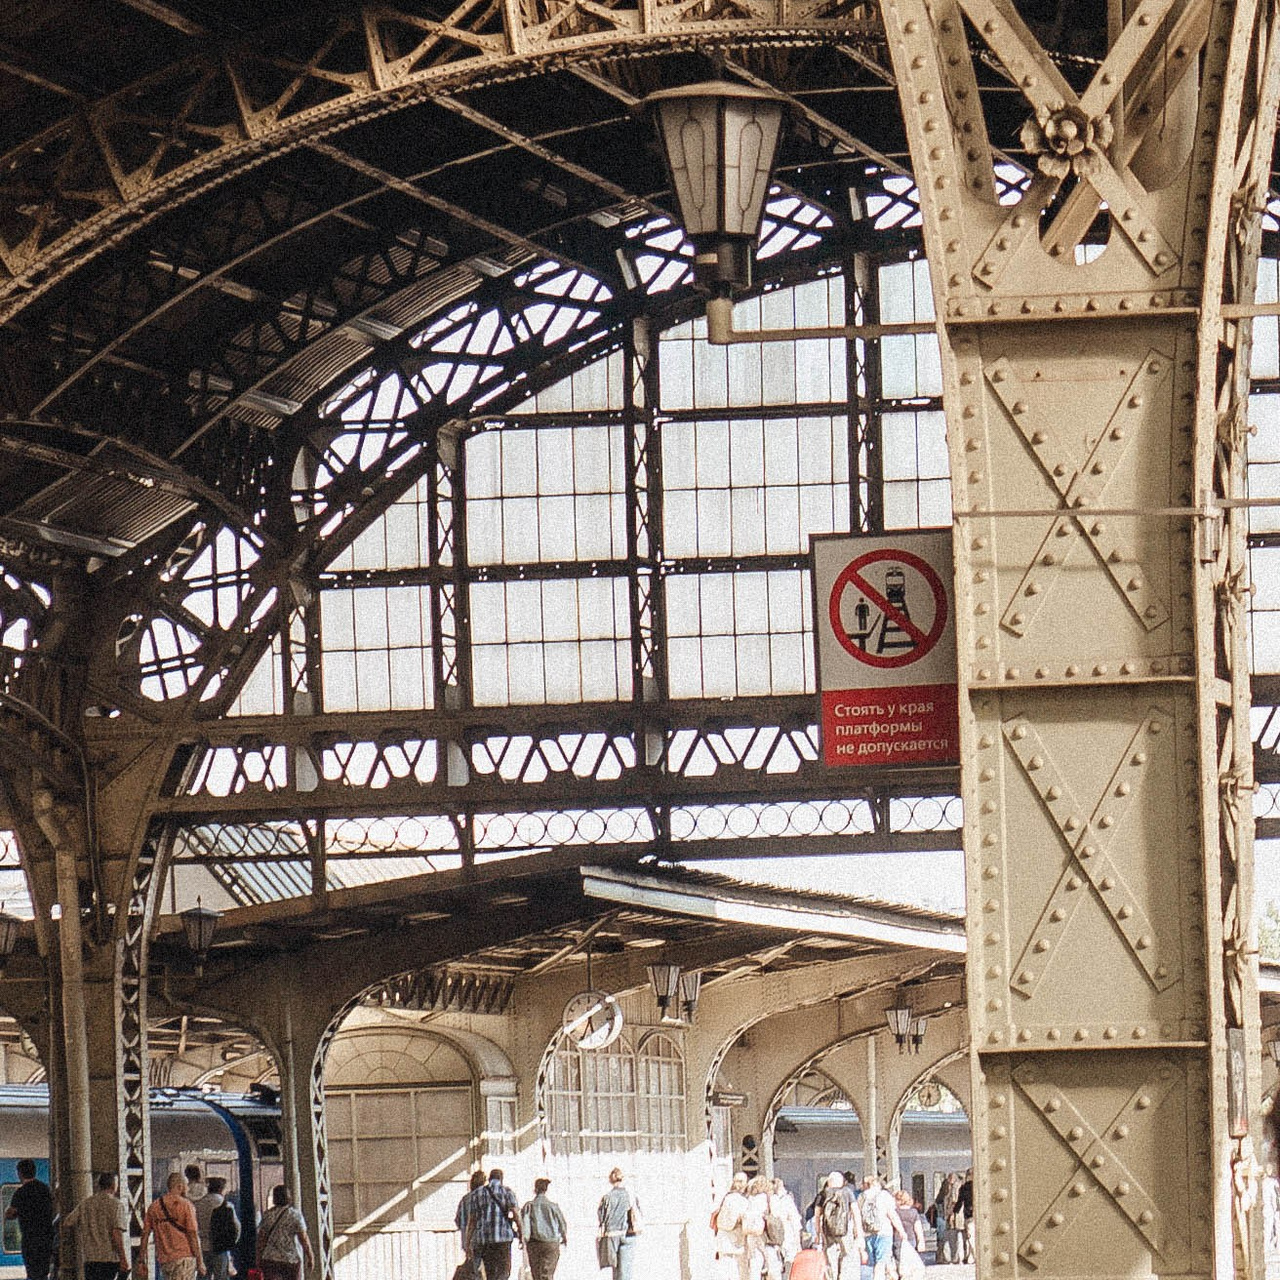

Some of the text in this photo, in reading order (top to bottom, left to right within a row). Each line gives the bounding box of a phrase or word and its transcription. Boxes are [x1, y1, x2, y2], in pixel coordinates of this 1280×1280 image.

[834, 702, 934, 718] Стоять у края
[835, 721, 923, 737] платформы
[836, 738, 949, 756] не допускается
